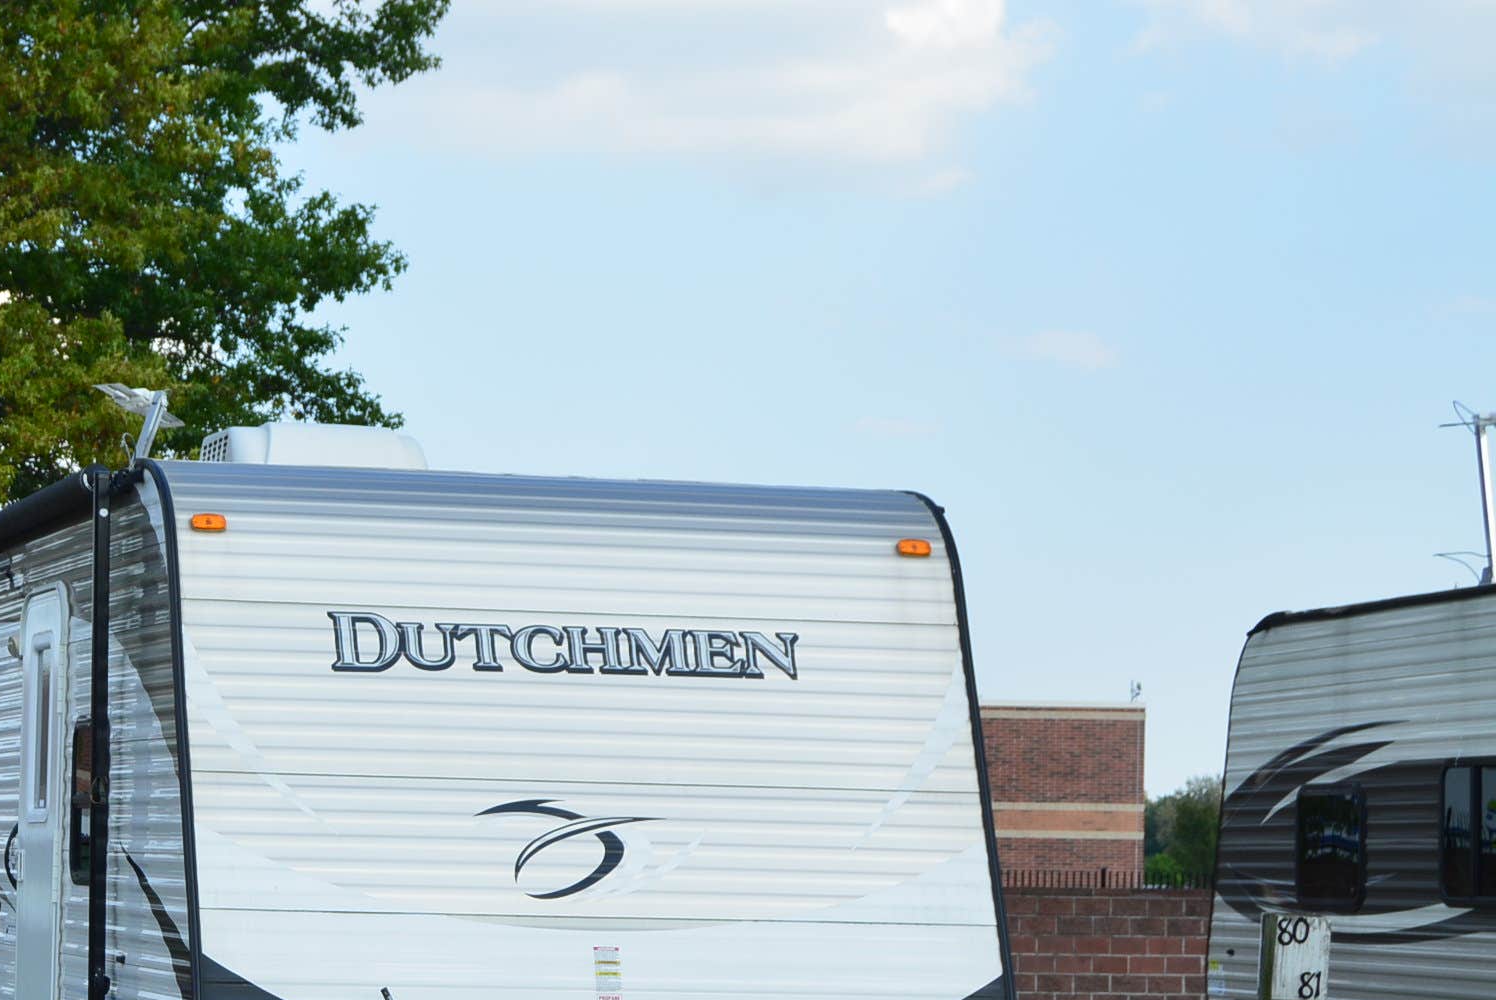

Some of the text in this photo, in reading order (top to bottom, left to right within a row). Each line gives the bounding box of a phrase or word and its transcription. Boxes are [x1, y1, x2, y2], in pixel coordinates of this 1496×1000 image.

[327, 611, 799, 680] DUTCHMEN
[1277, 916, 1310, 946] 80
[1298, 970, 1322, 999] 81
